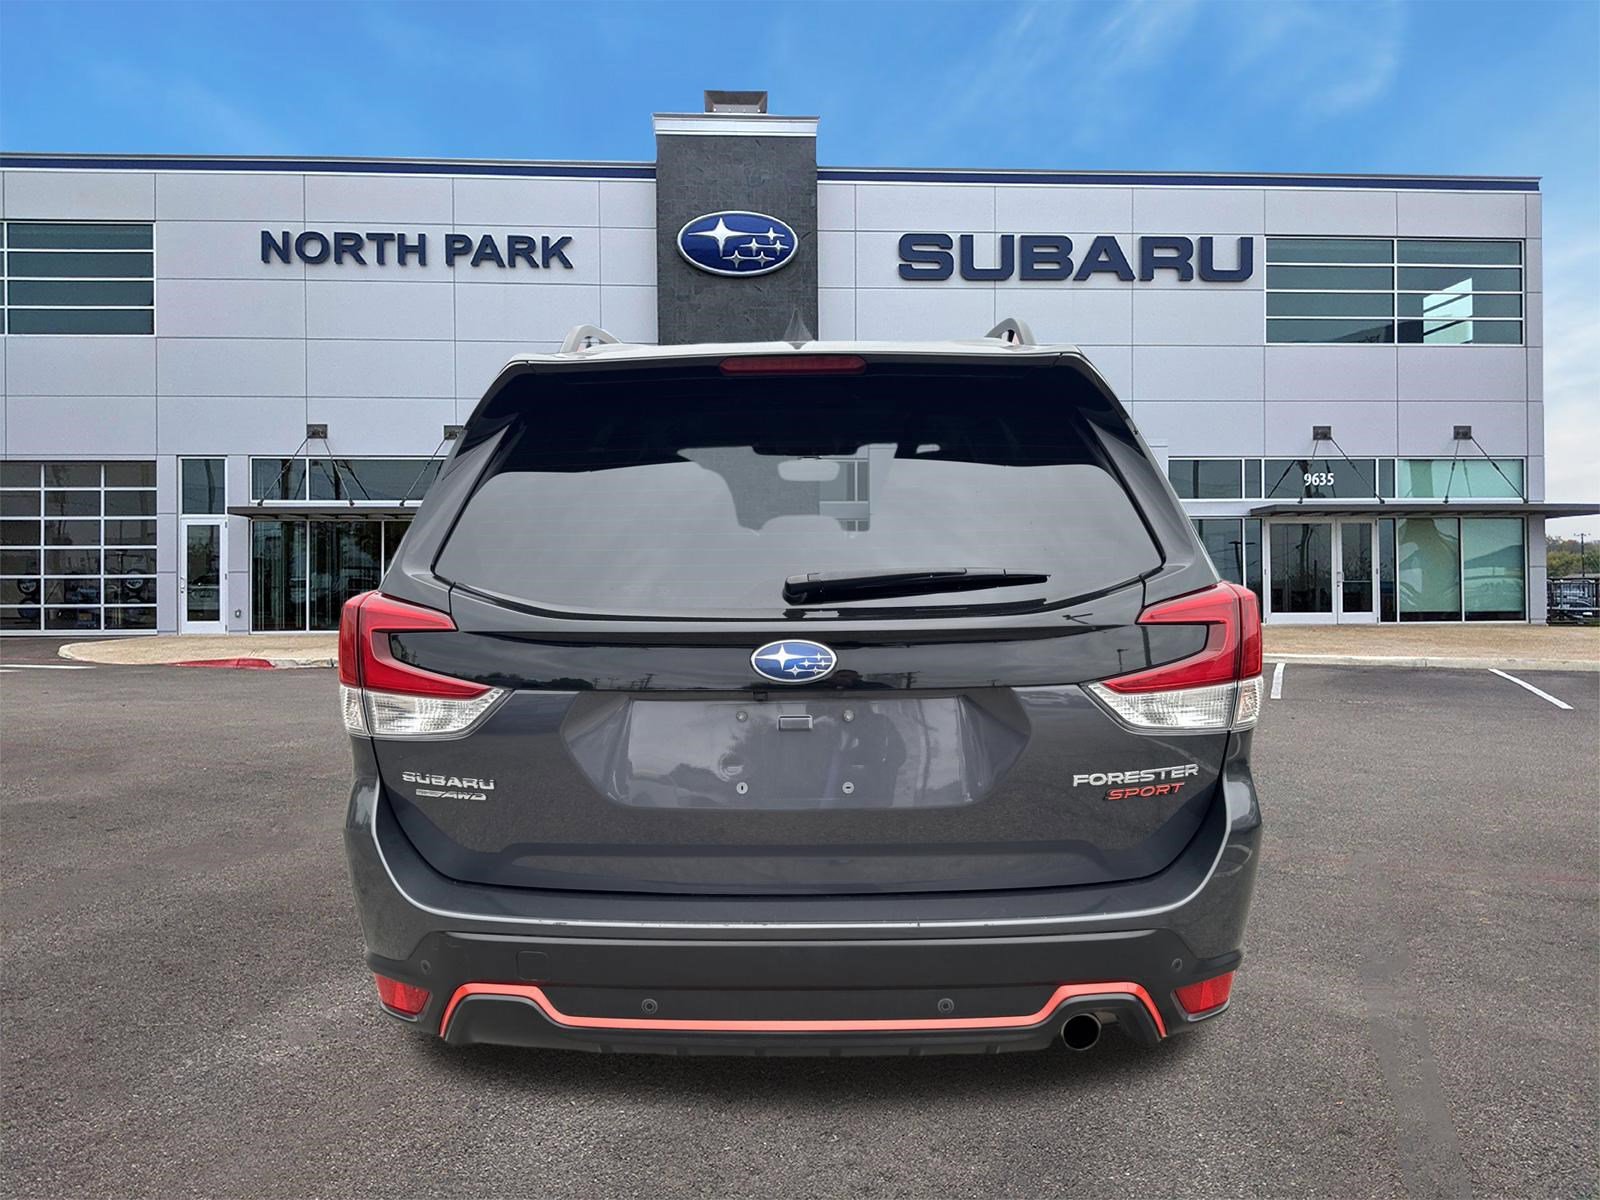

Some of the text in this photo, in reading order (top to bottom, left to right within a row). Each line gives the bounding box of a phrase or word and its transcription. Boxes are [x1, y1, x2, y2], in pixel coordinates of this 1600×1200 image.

[260, 230, 573, 269] NORTH PARK
[898, 232, 1254, 282] SUBARU
[1303, 472, 1335, 486] 9635
[402, 771, 495, 790] SUBARU
[1072, 763, 1199, 787] FORESTER
[1105, 781, 1185, 800] SPORT
